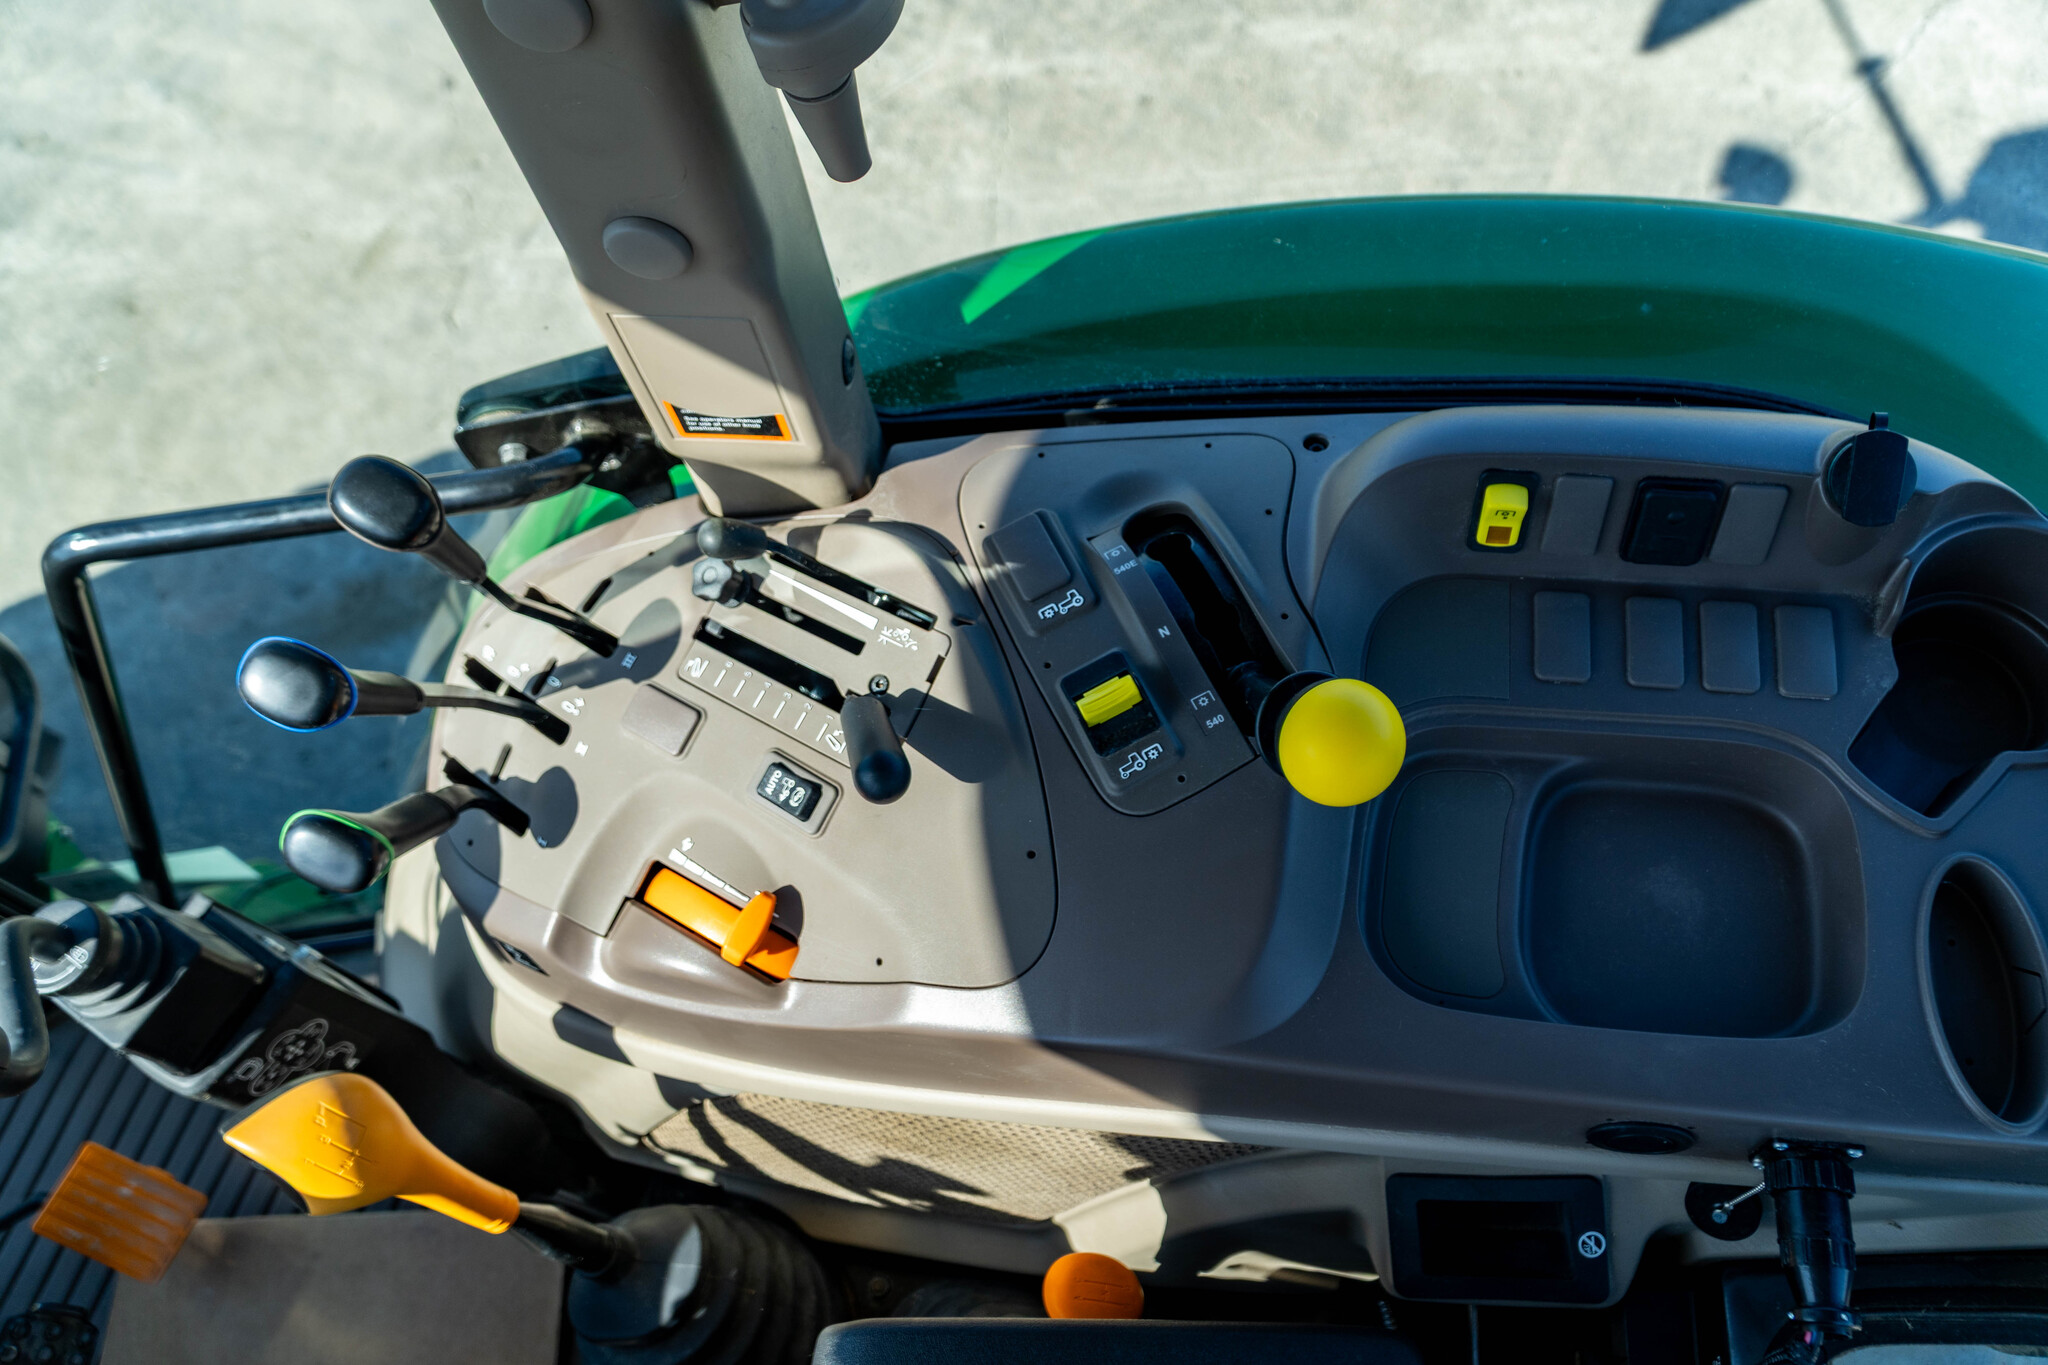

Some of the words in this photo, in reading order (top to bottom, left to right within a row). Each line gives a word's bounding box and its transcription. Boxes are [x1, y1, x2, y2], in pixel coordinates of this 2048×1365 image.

[1113, 559, 1138, 575] 540E
[1157, 625, 1171, 638] N
[1205, 713, 1225, 729] 540
[764, 769, 782, 796] AUTO
